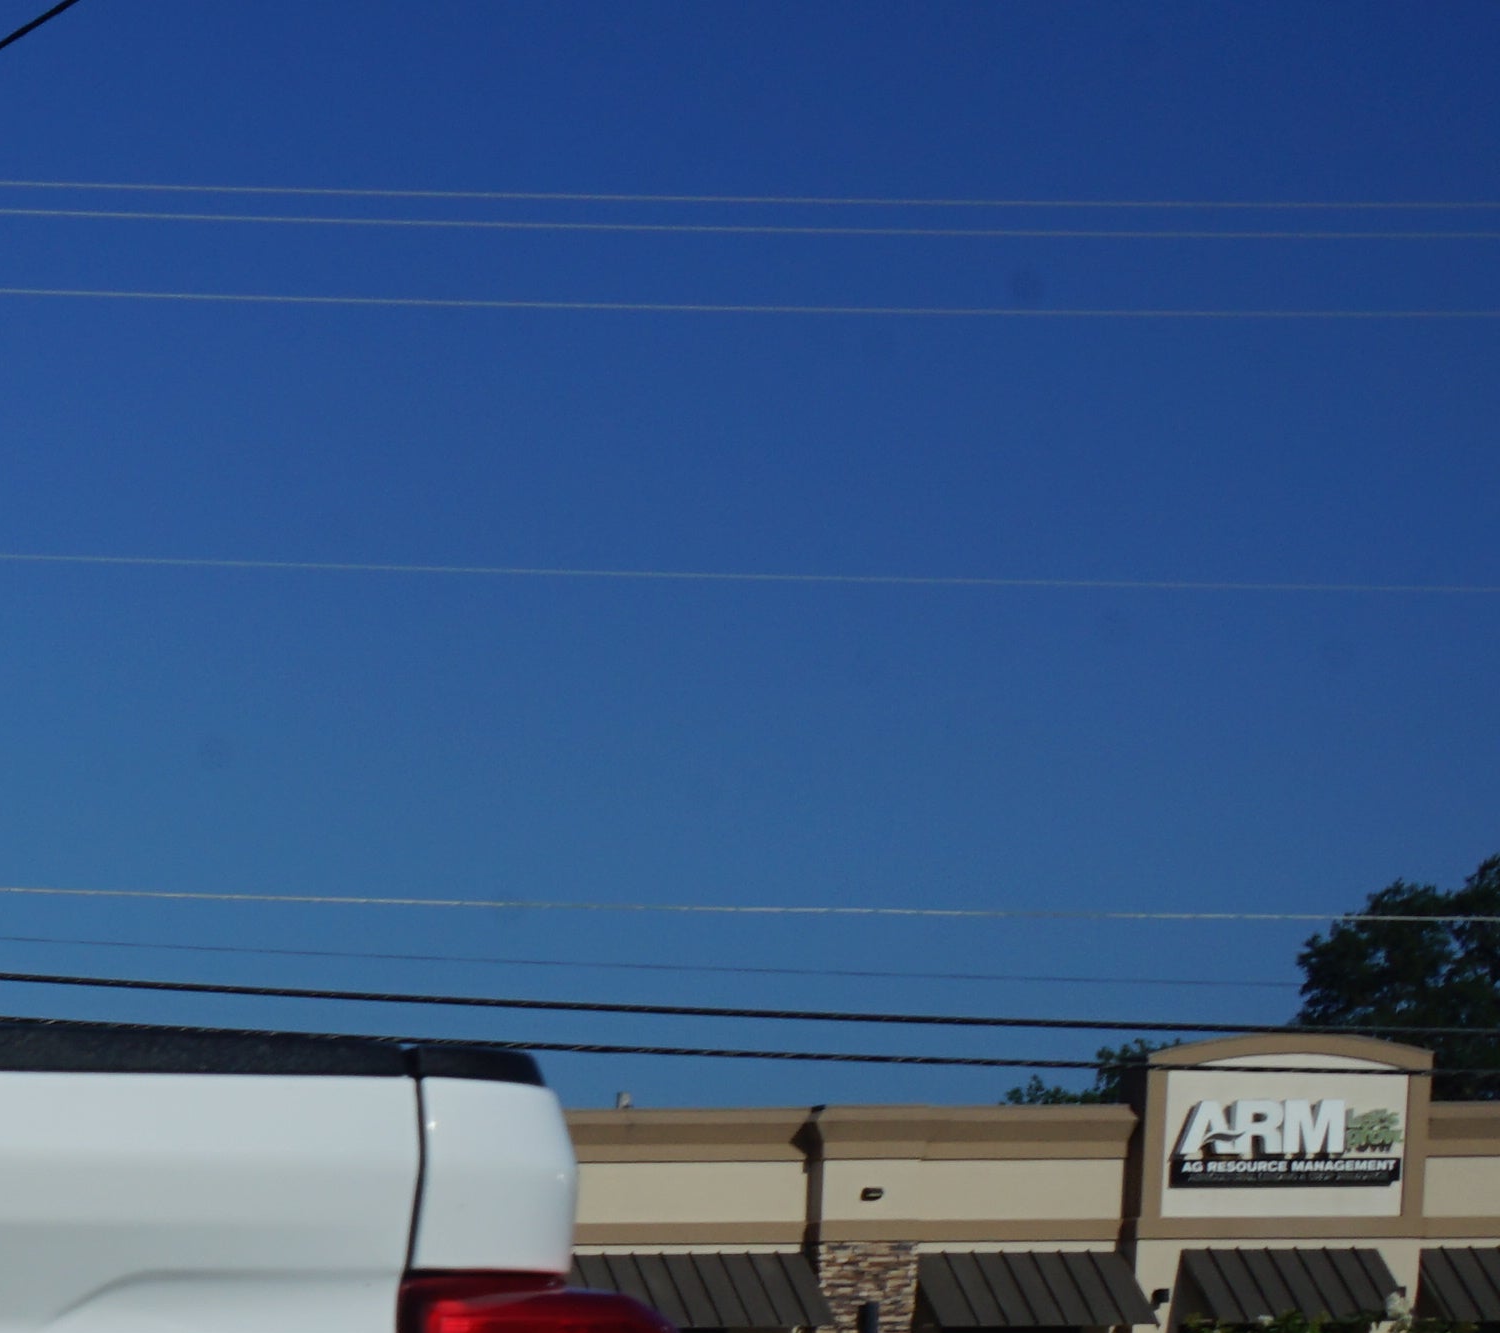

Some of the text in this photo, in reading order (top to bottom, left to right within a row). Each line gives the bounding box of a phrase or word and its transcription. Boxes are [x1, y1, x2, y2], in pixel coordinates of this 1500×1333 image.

[1178, 1098, 1348, 1154] ARM
[1181, 1159, 1396, 1173] AG RESOURCE MANAGEMENT
